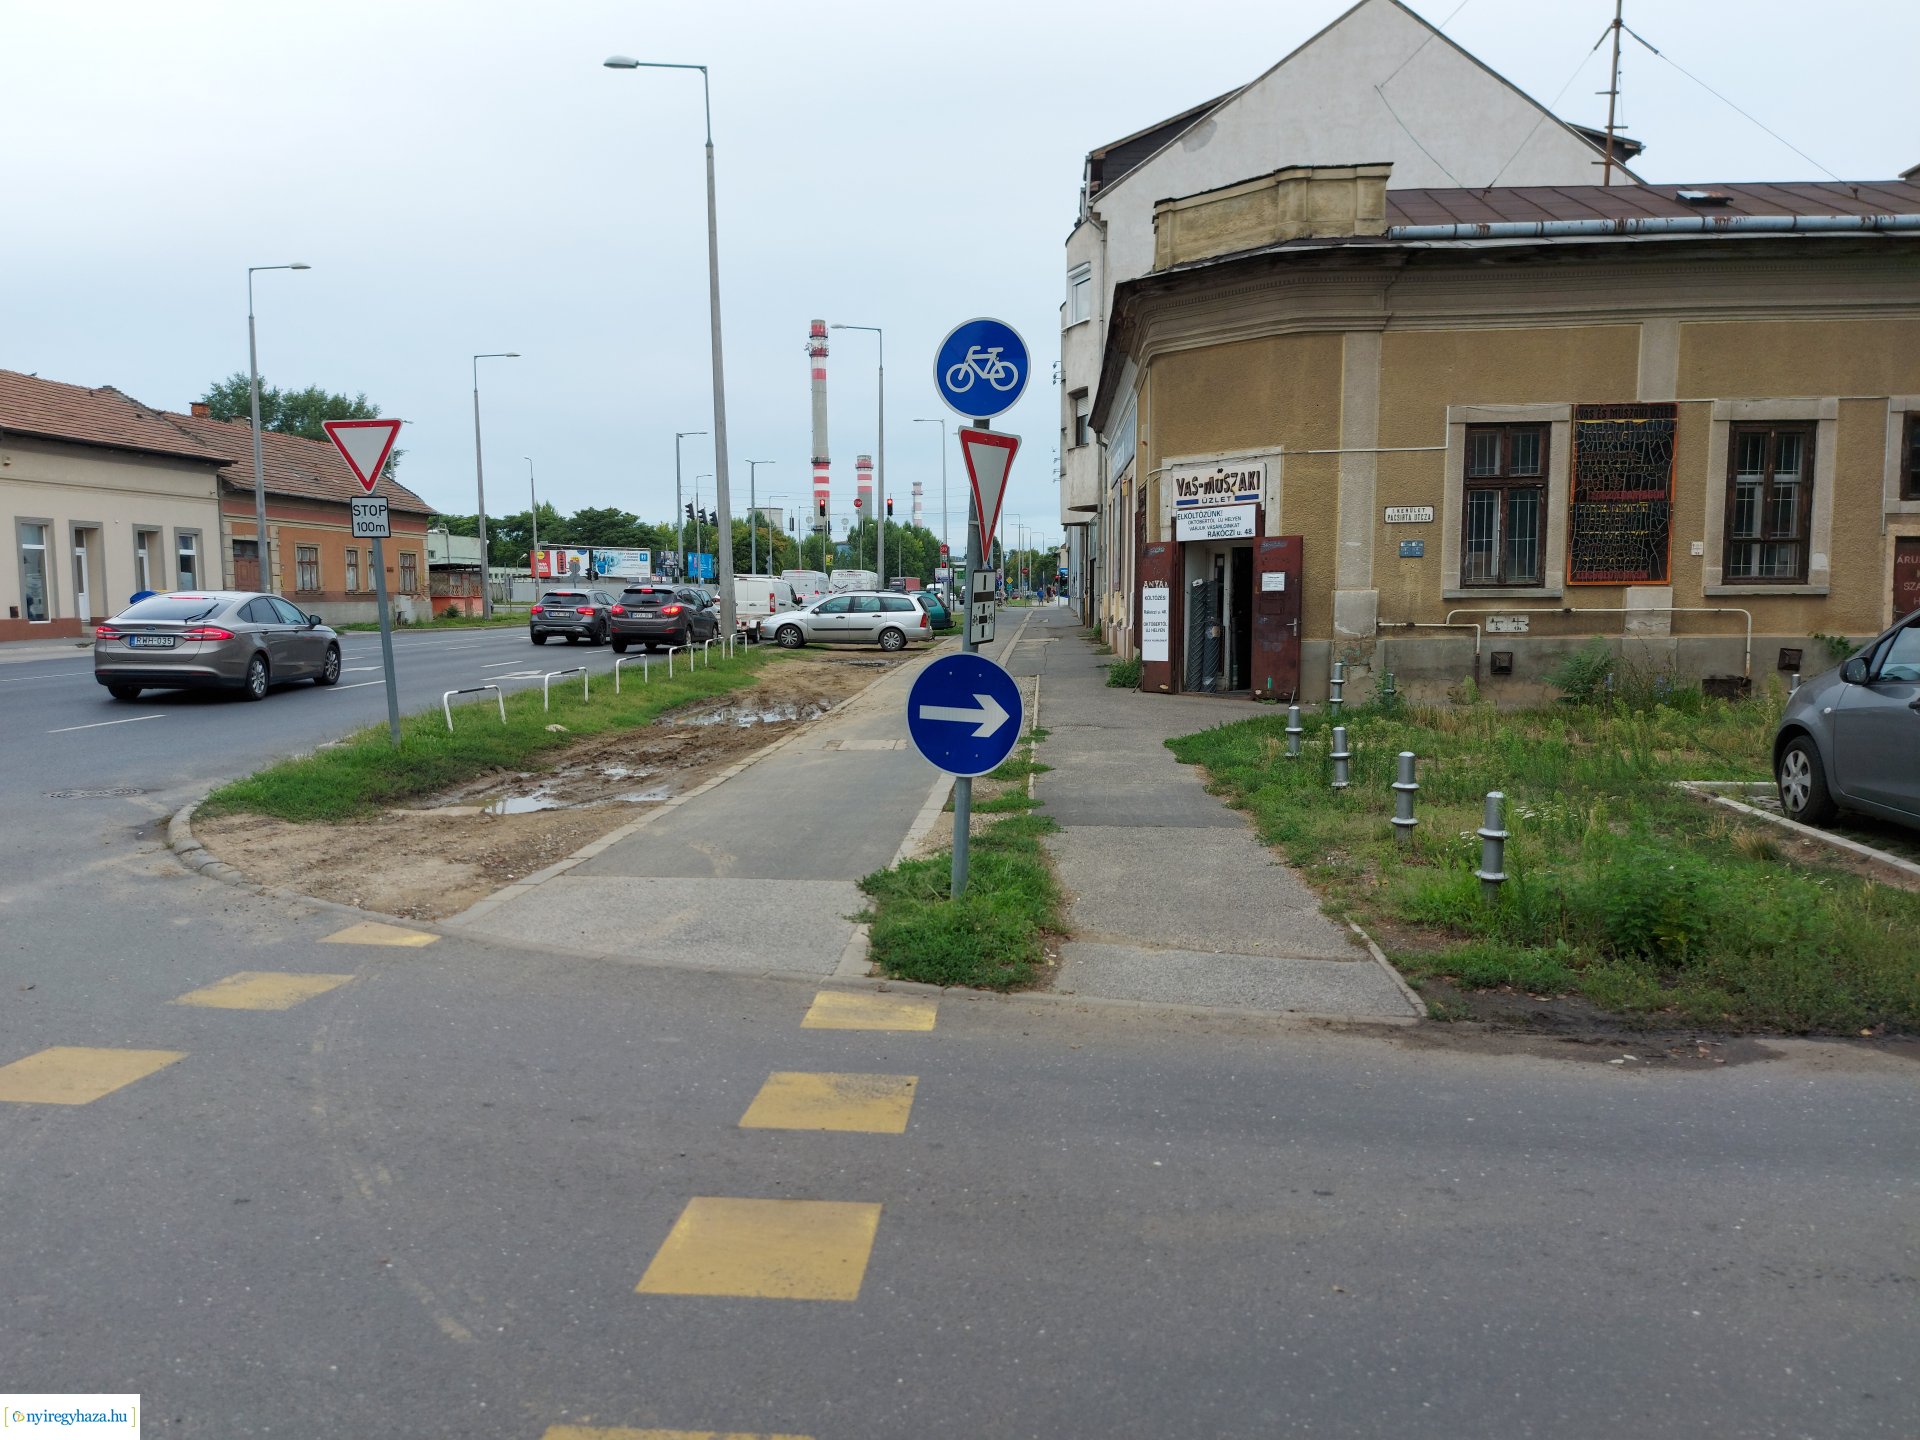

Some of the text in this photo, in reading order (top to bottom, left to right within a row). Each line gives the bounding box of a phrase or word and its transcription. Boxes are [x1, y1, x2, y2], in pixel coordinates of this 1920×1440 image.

[1202, 496, 1231, 504] ÜZLET
[352, 504, 387, 517] STOP
[357, 521, 386, 532] 100m
[1896, 553, 1920, 564] ÁRU
[136, 637, 172, 645] RWH-035
